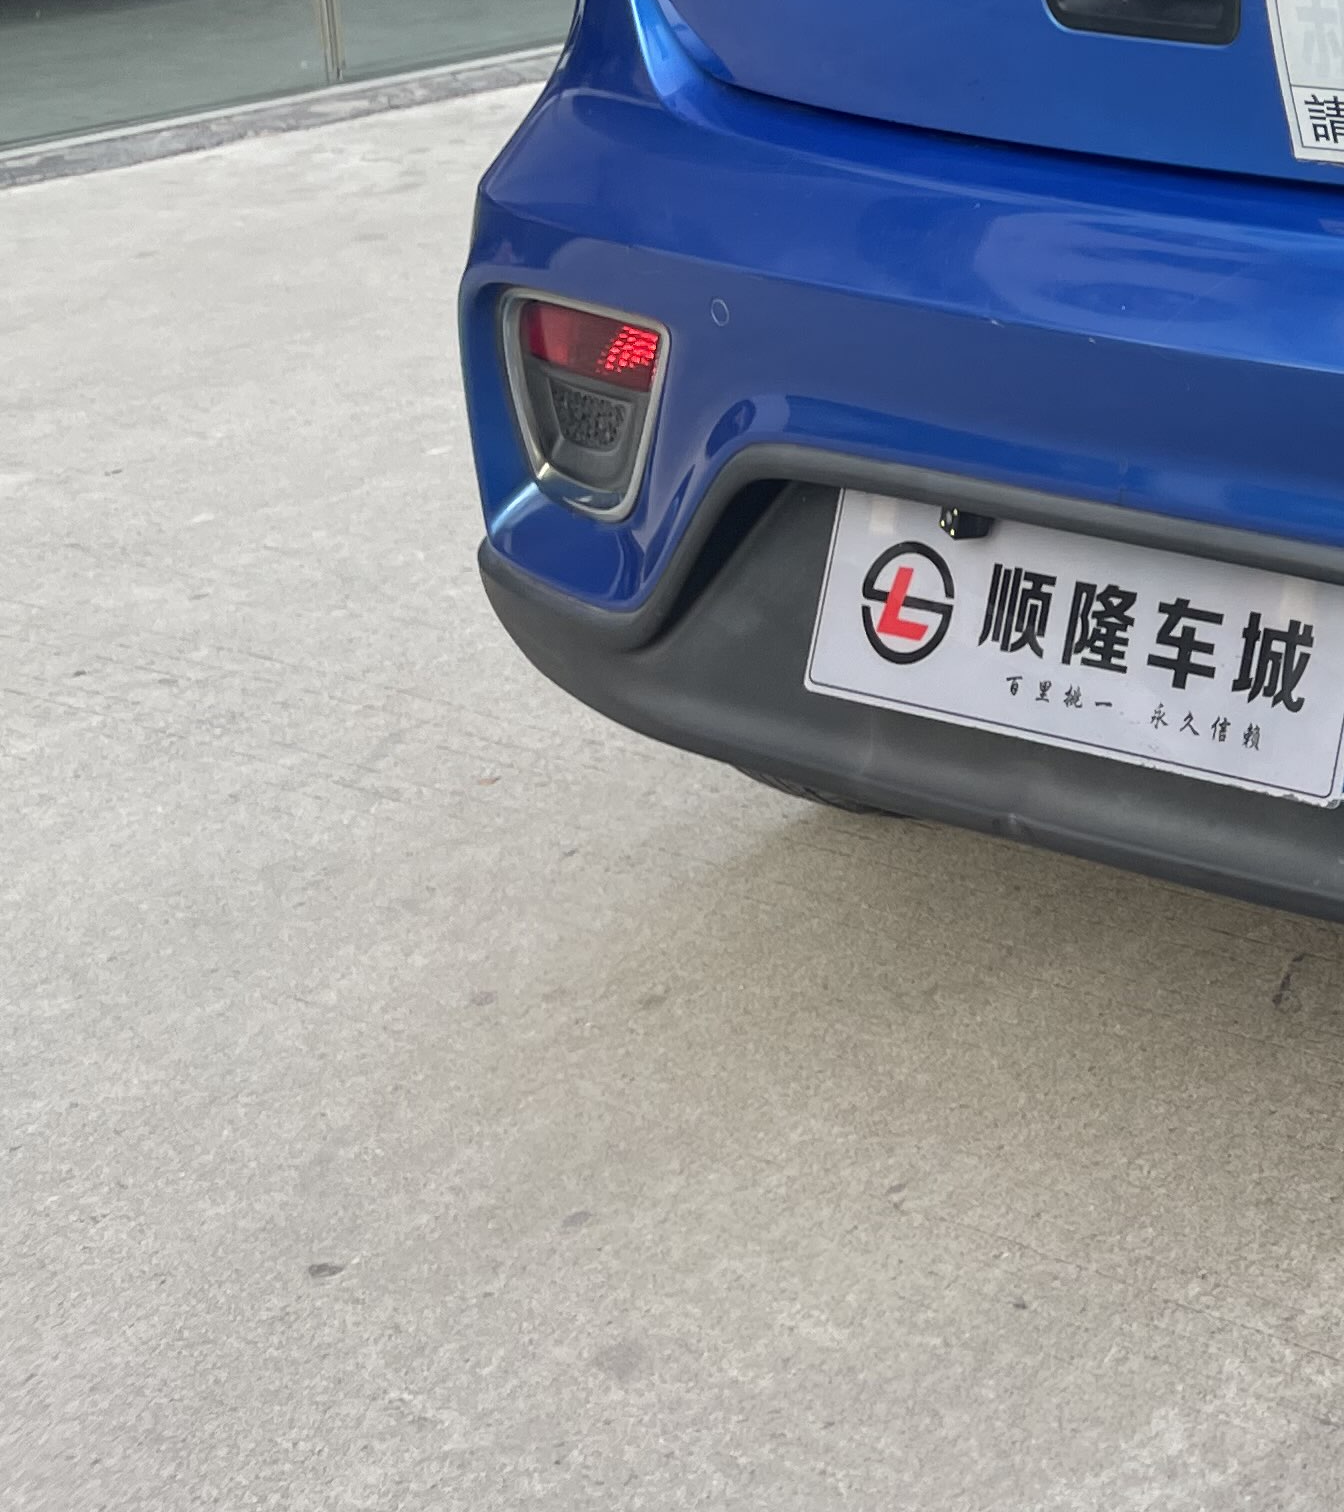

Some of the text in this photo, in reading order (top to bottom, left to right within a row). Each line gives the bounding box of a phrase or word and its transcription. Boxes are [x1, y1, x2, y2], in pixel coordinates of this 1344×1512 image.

[978, 563, 1314, 713] 顺隆车城
[1006, 675, 1112, 709] 百里挑一
